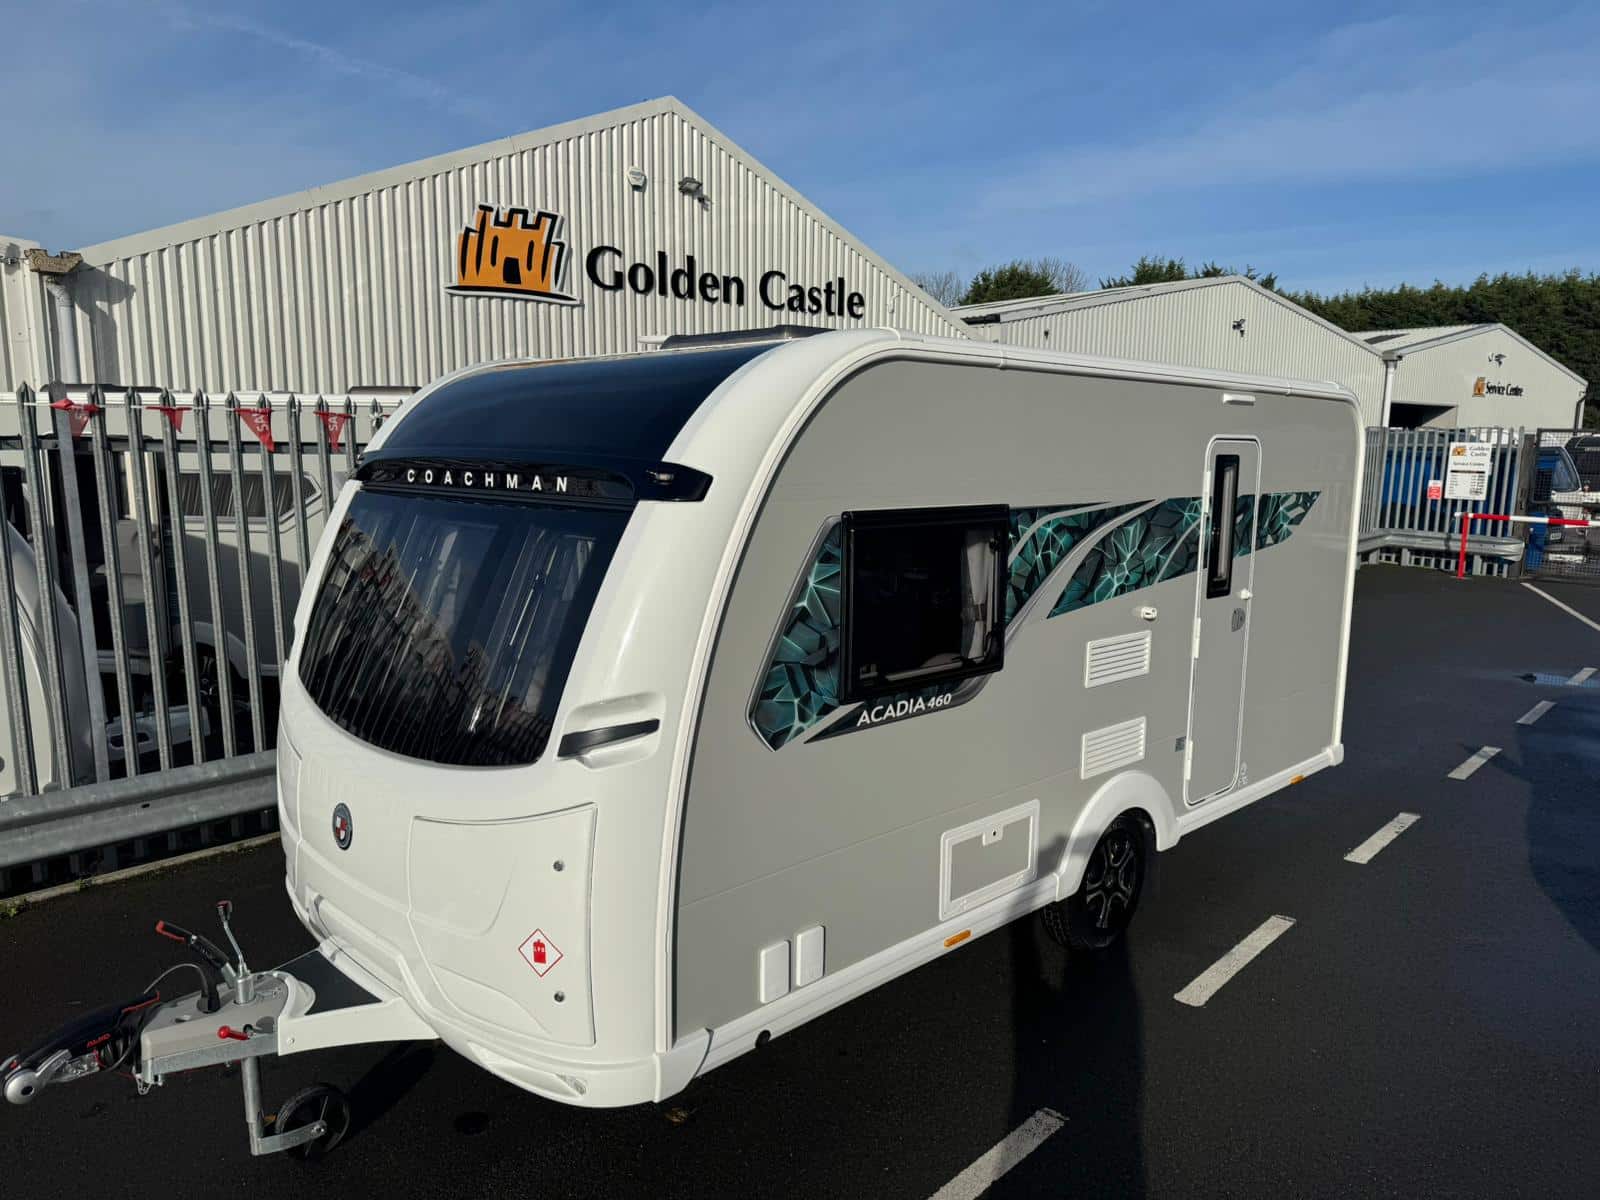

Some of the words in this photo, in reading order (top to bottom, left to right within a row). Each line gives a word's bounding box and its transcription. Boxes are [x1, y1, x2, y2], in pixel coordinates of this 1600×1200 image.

[585, 245, 745, 306] Golden
[758, 269, 866, 320] Castle
[1485, 381, 1505, 395] Service
[1506, 383, 1523, 396] Centre
[406, 469, 569, 493] COACHMAN
[856, 696, 926, 727] ACADIA
[927, 692, 953, 710] 460
